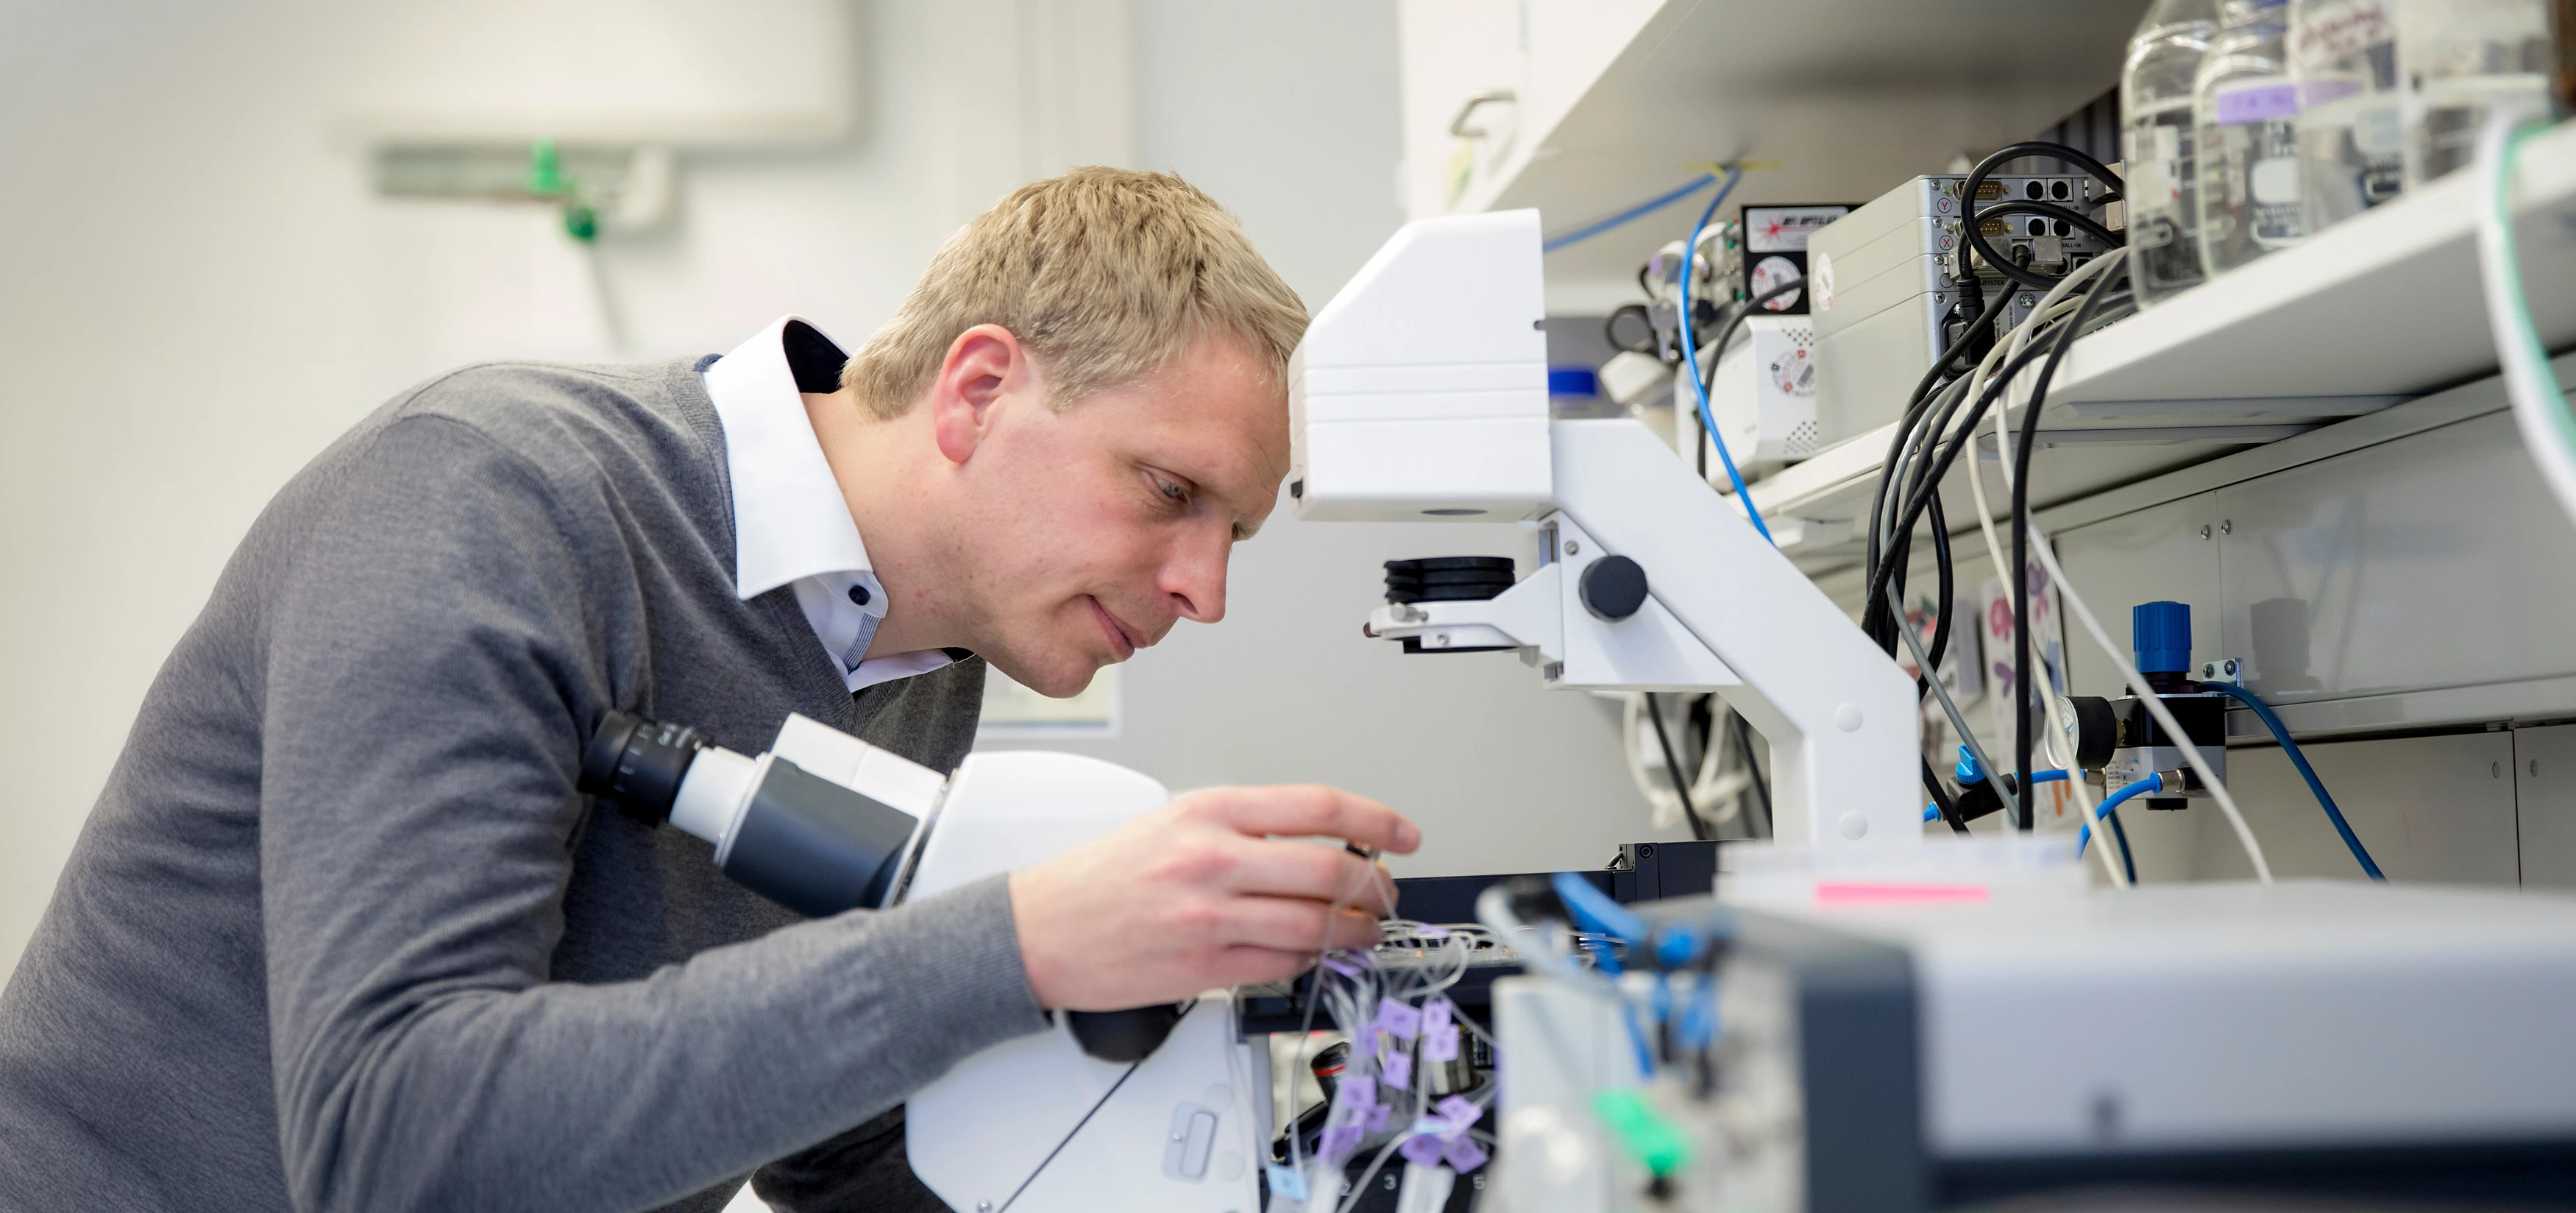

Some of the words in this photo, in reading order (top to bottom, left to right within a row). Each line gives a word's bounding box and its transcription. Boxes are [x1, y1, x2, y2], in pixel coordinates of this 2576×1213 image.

[1941, 202, 1948, 211] Y
[1943, 238, 1951, 247] X
[1383, 1173, 1397, 1190] 3
[1472, 1173, 1486, 1190] 5
